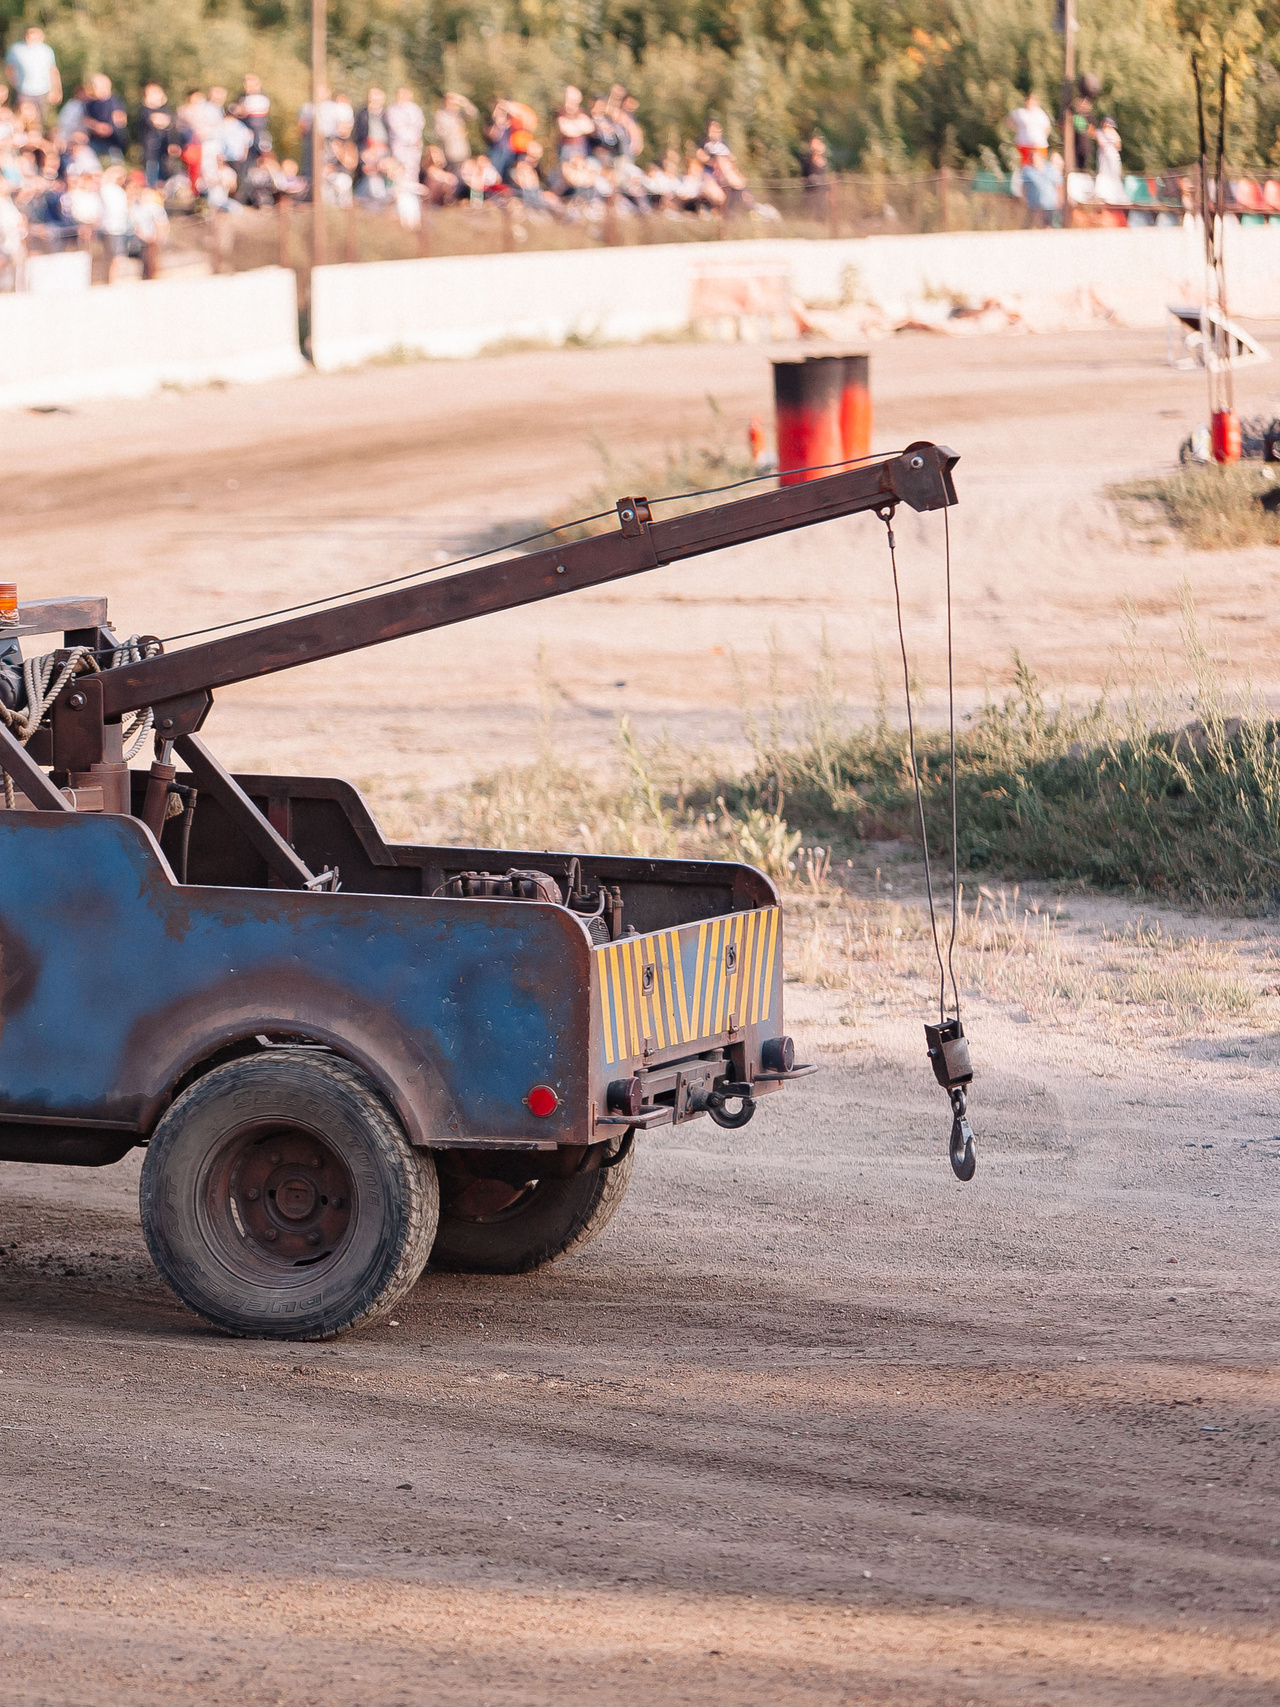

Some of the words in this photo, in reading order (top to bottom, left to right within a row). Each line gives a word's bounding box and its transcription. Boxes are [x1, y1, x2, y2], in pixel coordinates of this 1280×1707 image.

[232, 1088, 380, 1207] BRIDGESTONE
[164, 1173, 186, 1243] A/T
[184, 1260, 323, 1314] DUELER
